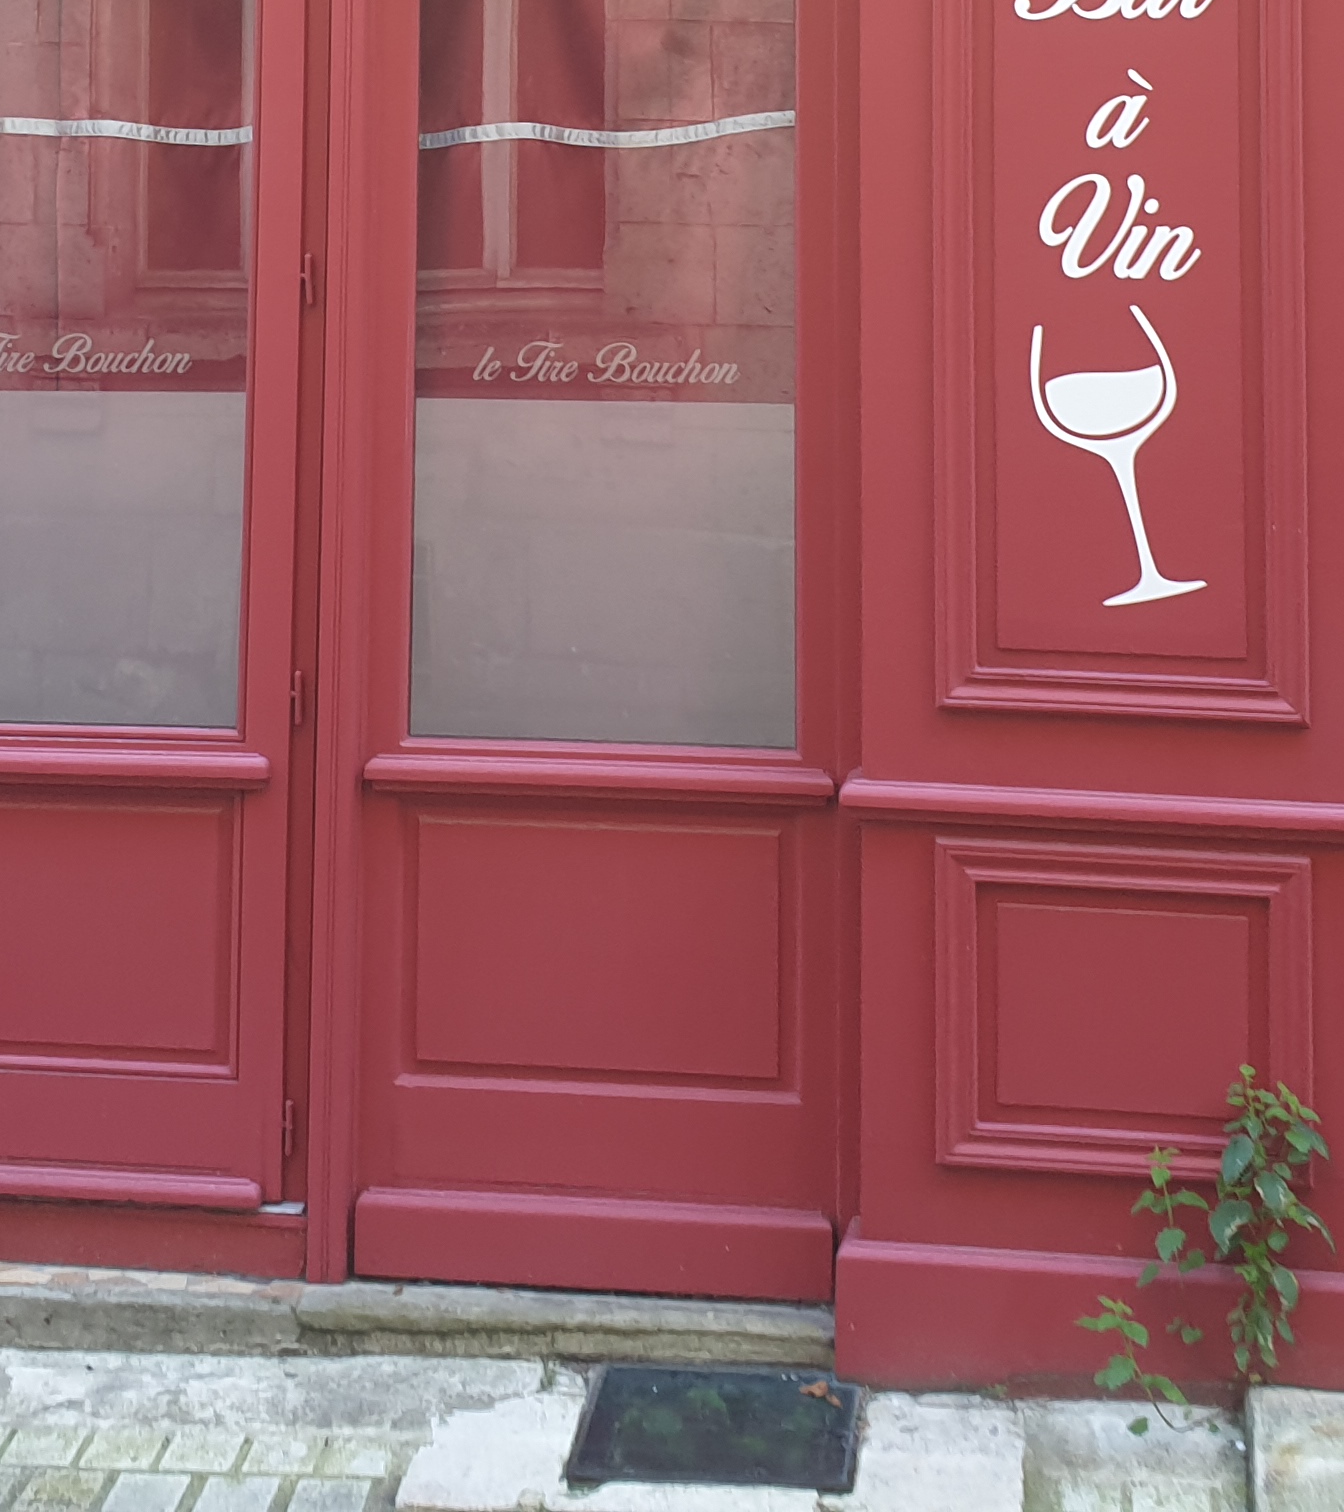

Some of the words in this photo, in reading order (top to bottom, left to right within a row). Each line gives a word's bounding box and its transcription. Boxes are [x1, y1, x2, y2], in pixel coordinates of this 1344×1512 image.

[1085, 68, 1154, 149] à
[1038, 173, 1202, 281] Vin
[43, 333, 192, 374] Bouchon
[472, 346, 502, 381] le
[510, 341, 579, 382] Tire
[587, 342, 741, 385] Bouchon
